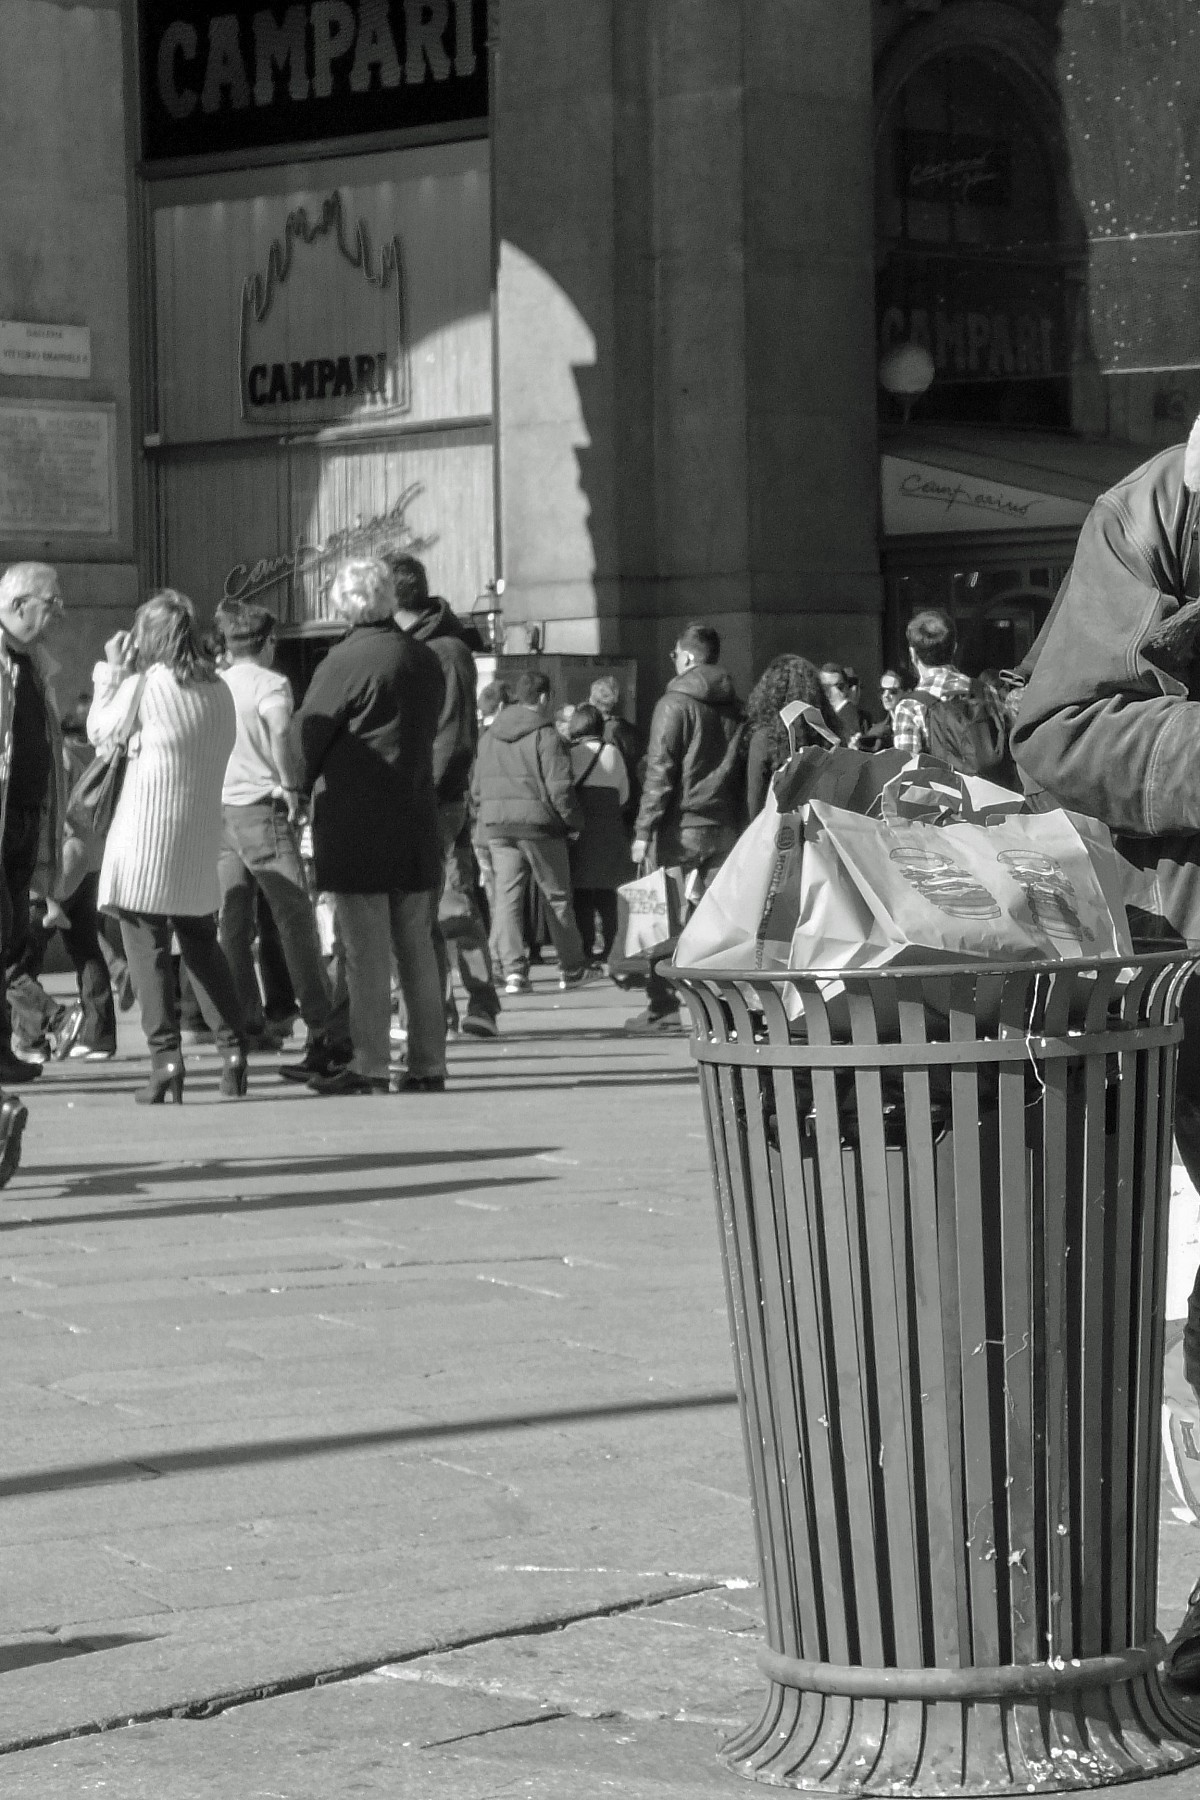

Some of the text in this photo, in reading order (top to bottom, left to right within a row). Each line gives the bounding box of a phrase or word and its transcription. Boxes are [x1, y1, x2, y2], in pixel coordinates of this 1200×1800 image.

[157, 0, 476, 119] CAMPARI
[881, 306, 1052, 373] CAMPARI
[248, 352, 388, 406] CAMPARI
[754, 931, 767, 971] WHOPP
